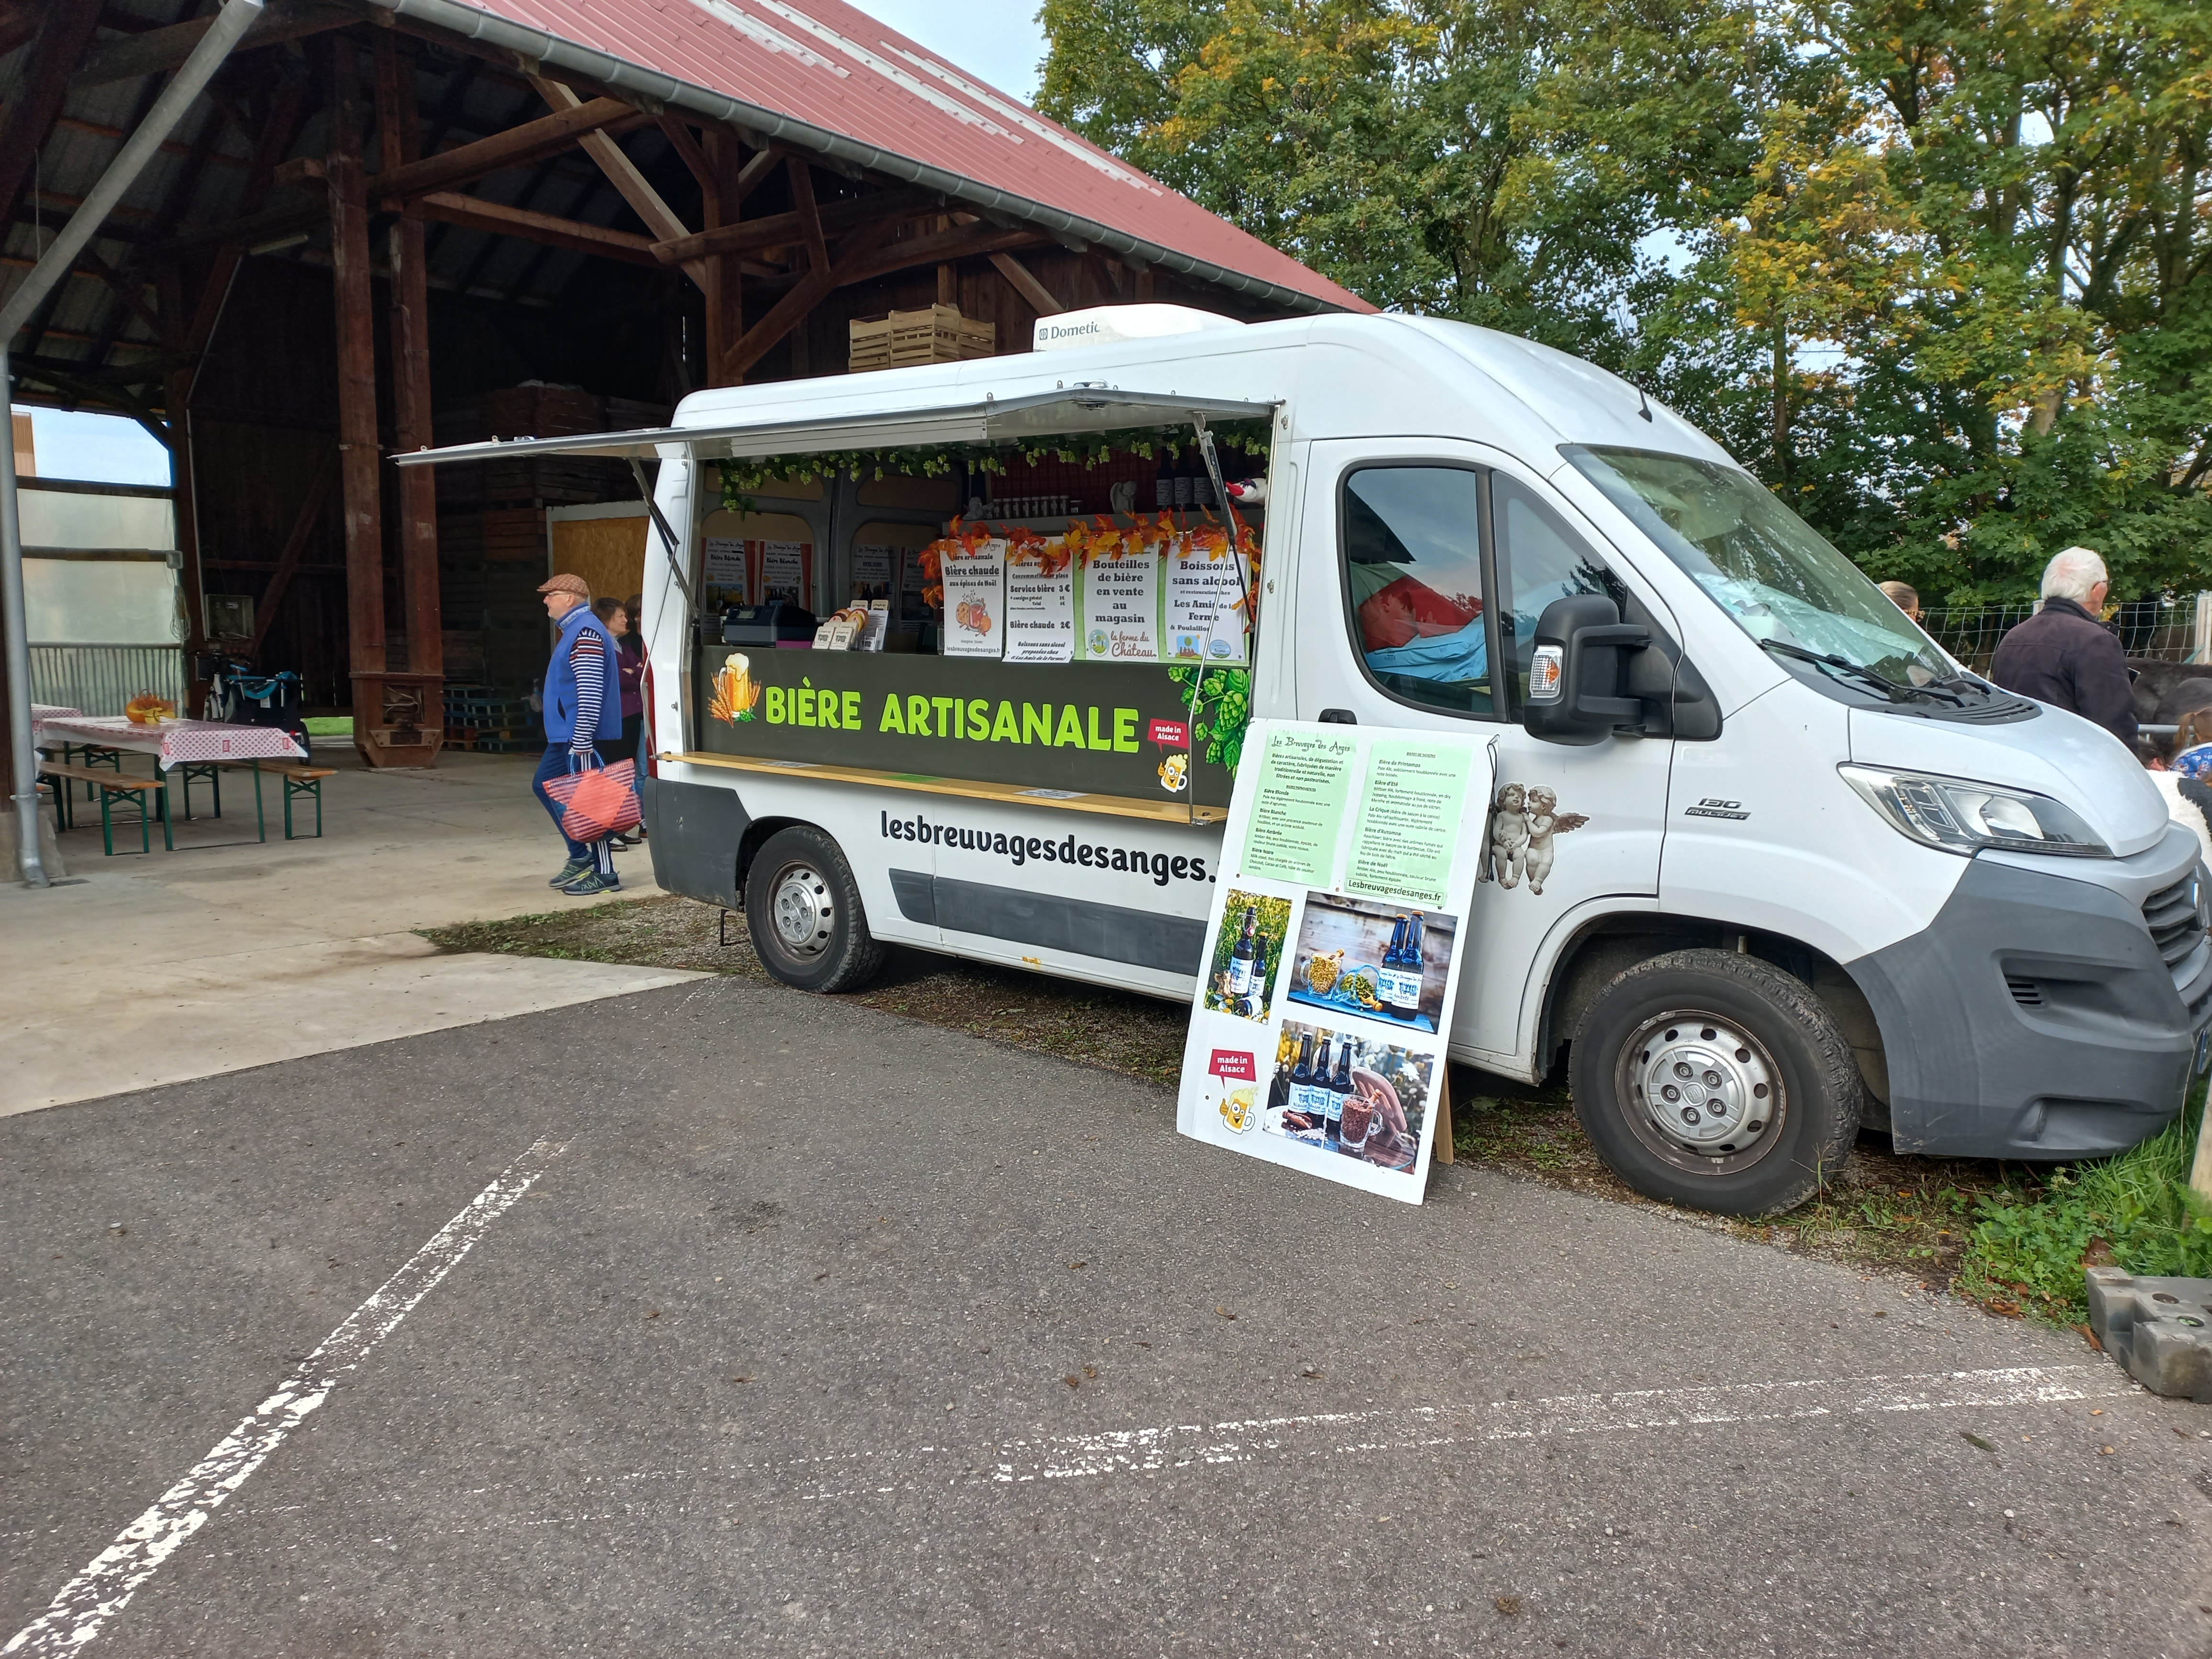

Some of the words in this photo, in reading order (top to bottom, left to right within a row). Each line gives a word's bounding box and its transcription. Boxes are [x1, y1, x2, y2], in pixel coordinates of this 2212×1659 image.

[1051, 321, 1100, 339] Dometic
[945, 564, 967, 575] Bière
[969, 565, 999, 575] chaude
[1093, 560, 1150, 569] Bouteilles
[1180, 561, 1235, 571] Boissons
[1098, 573, 1111, 582] de
[1114, 573, 1143, 582] bière
[1172, 577, 1201, 586] sans
[1202, 575, 1240, 586] alcool
[960, 579, 976, 588] épices
[1037, 583, 1054, 592] bière
[1192, 600, 1216, 608] Amis
[1095, 614, 1145, 625] magasin
[1188, 612, 1219, 621] Ferme
[1010, 620, 1028, 629] Bière
[1030, 620, 1054, 629] chaude
[1110, 630, 1117, 641] la
[1118, 631, 1139, 643] ferme
[1139, 631, 1149, 641] du
[765, 675, 861, 730] BIÈRE
[879, 693, 1139, 753] ARTISANALE
[1157, 733, 1179, 741] Alsace
[1272, 736, 1282, 747] Les
[1284, 737, 1315, 752] Breuvages
[1315, 740, 1326, 749] des
[1329, 741, 1350, 755] Anges
[1315, 756, 1338, 765] dégustation
[1698, 798, 1741, 809] 130
[881, 810, 1219, 886] lesbreuvagesdesanges.
[1349, 880, 1441, 901] Lesbreuvagesdesanges.fr
